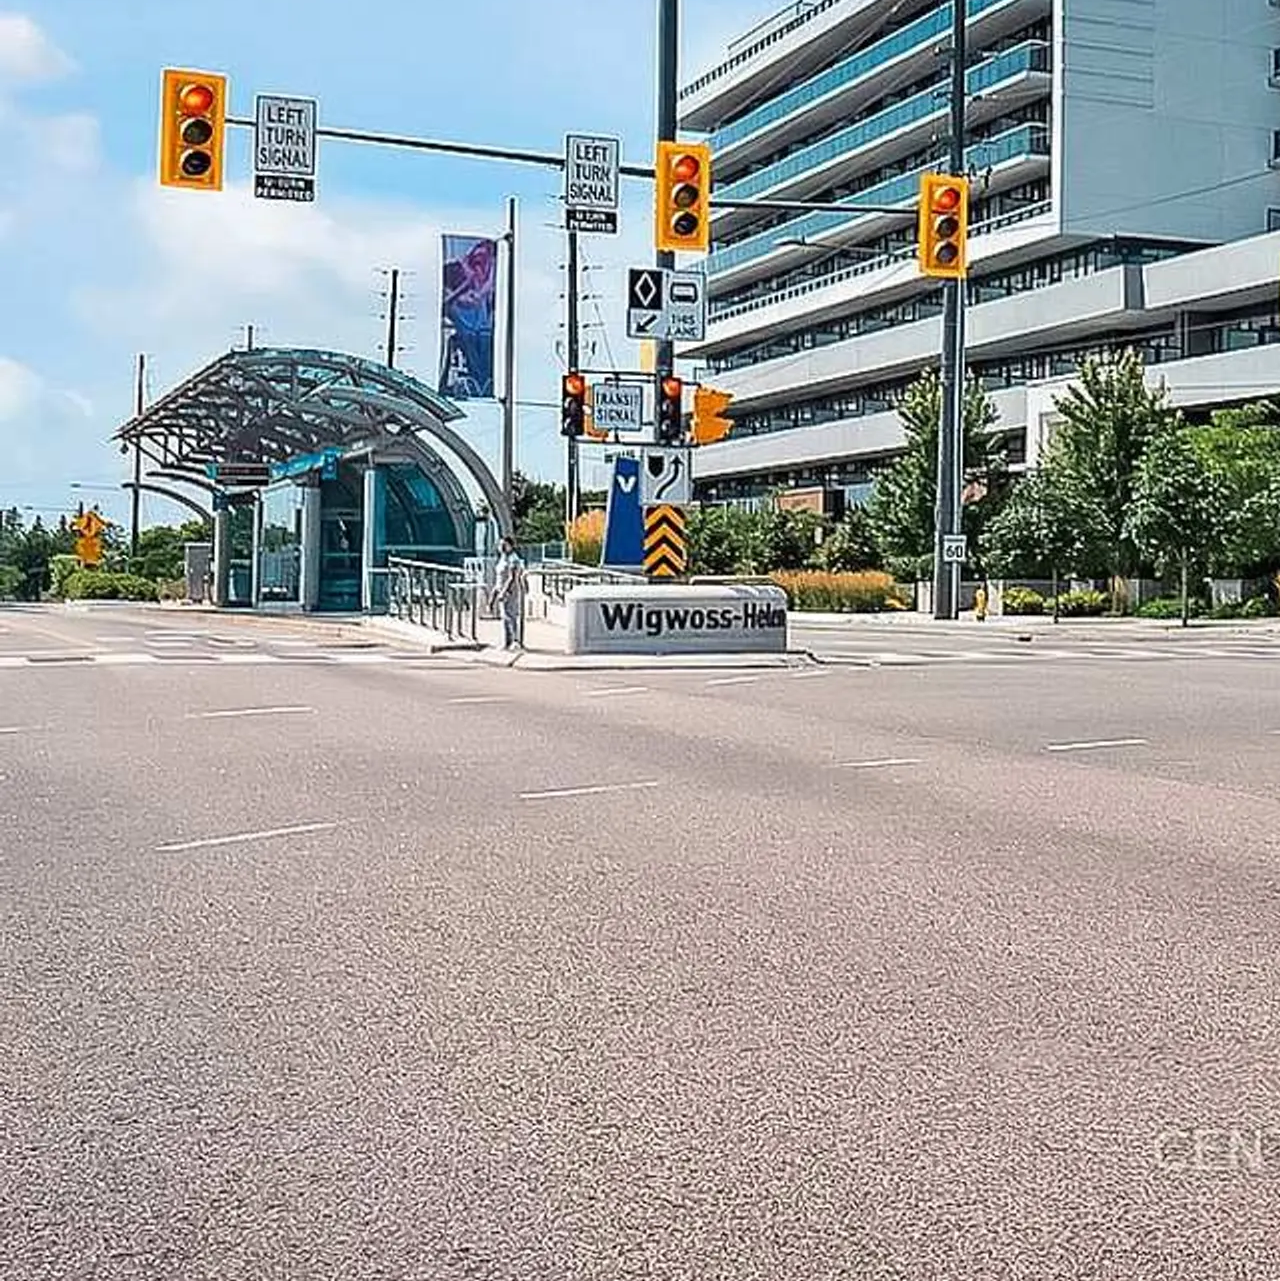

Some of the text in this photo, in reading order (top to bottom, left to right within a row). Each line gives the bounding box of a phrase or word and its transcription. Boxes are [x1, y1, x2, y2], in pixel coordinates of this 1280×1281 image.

[267, 106, 304, 125] LEFT
[266, 126, 306, 147] TURN
[259, 147, 310, 168] SIGNAL
[575, 143, 609, 163] LEFT
[575, 163, 611, 182] TURN
[569, 182, 614, 202] SIGNAL
[596, 408, 637, 425] SIGNAL
